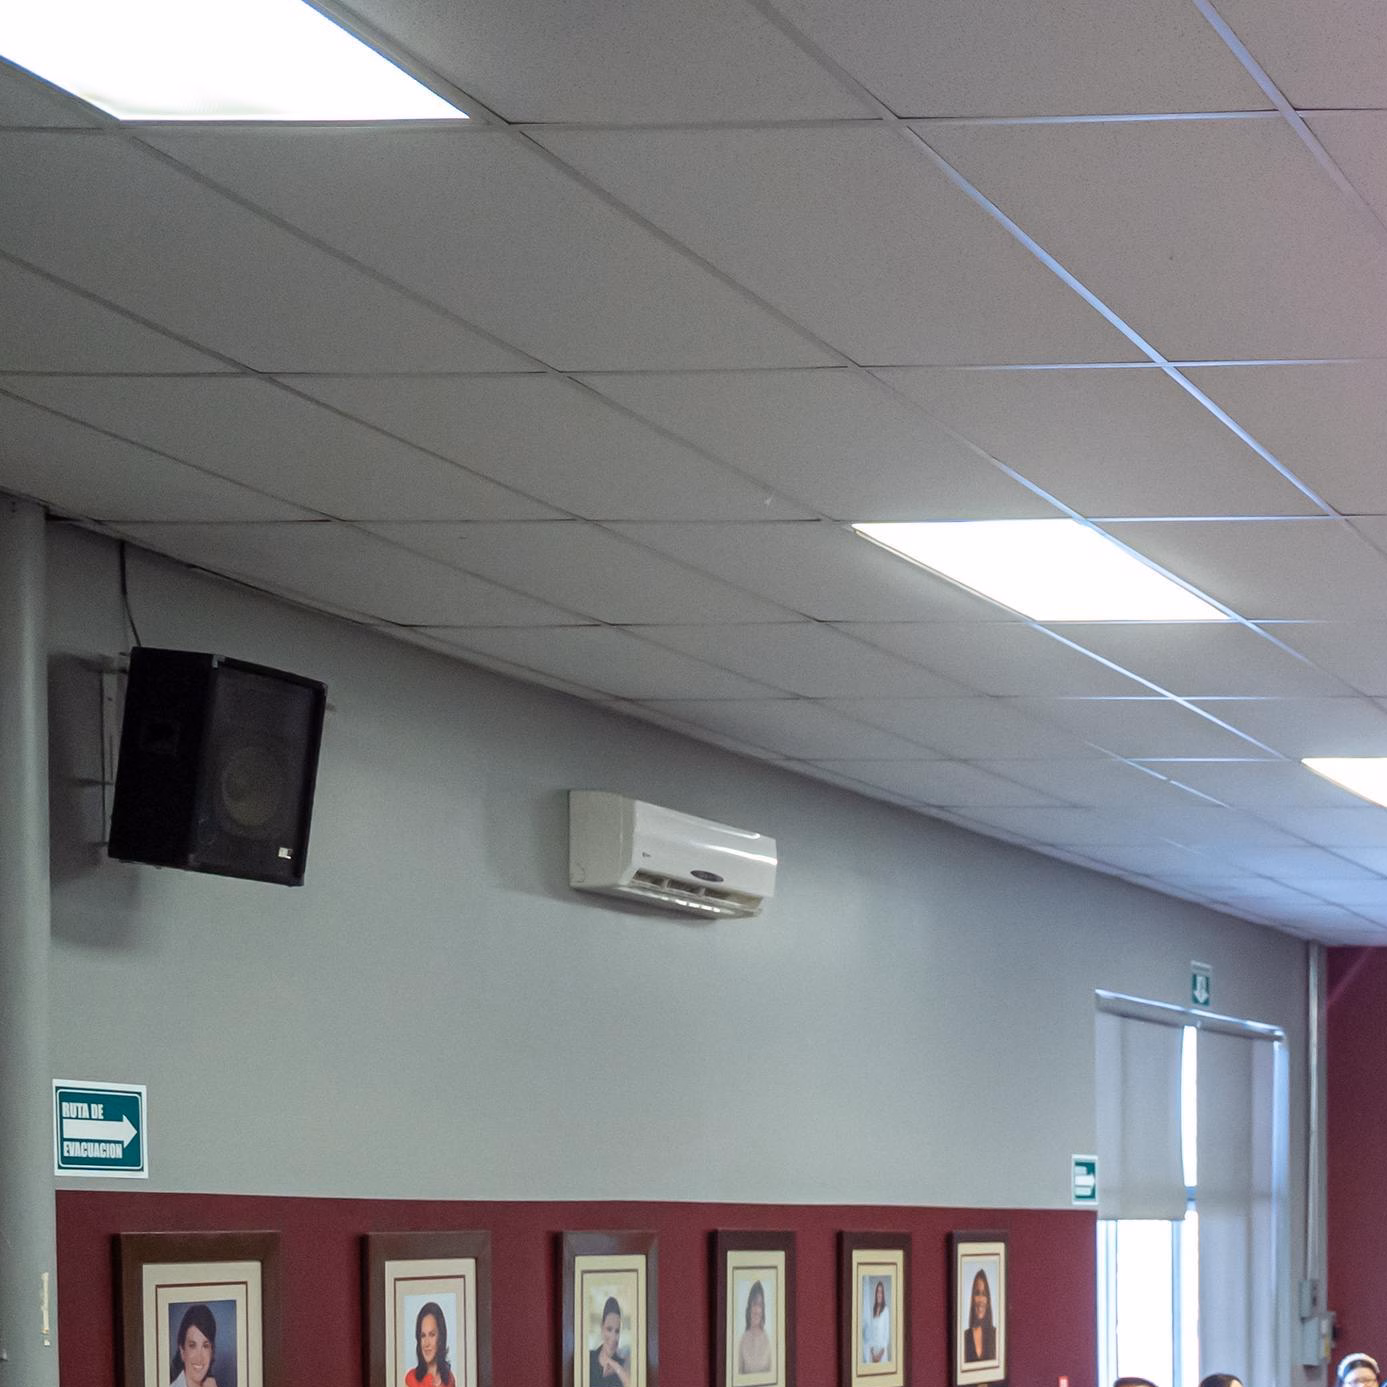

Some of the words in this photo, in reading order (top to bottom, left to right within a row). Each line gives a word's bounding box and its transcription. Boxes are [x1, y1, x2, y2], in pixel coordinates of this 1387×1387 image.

[61, 1102, 90, 1119] RUTA
[90, 1103, 104, 1120] DE
[63, 1141, 123, 1159] EVACUACION
